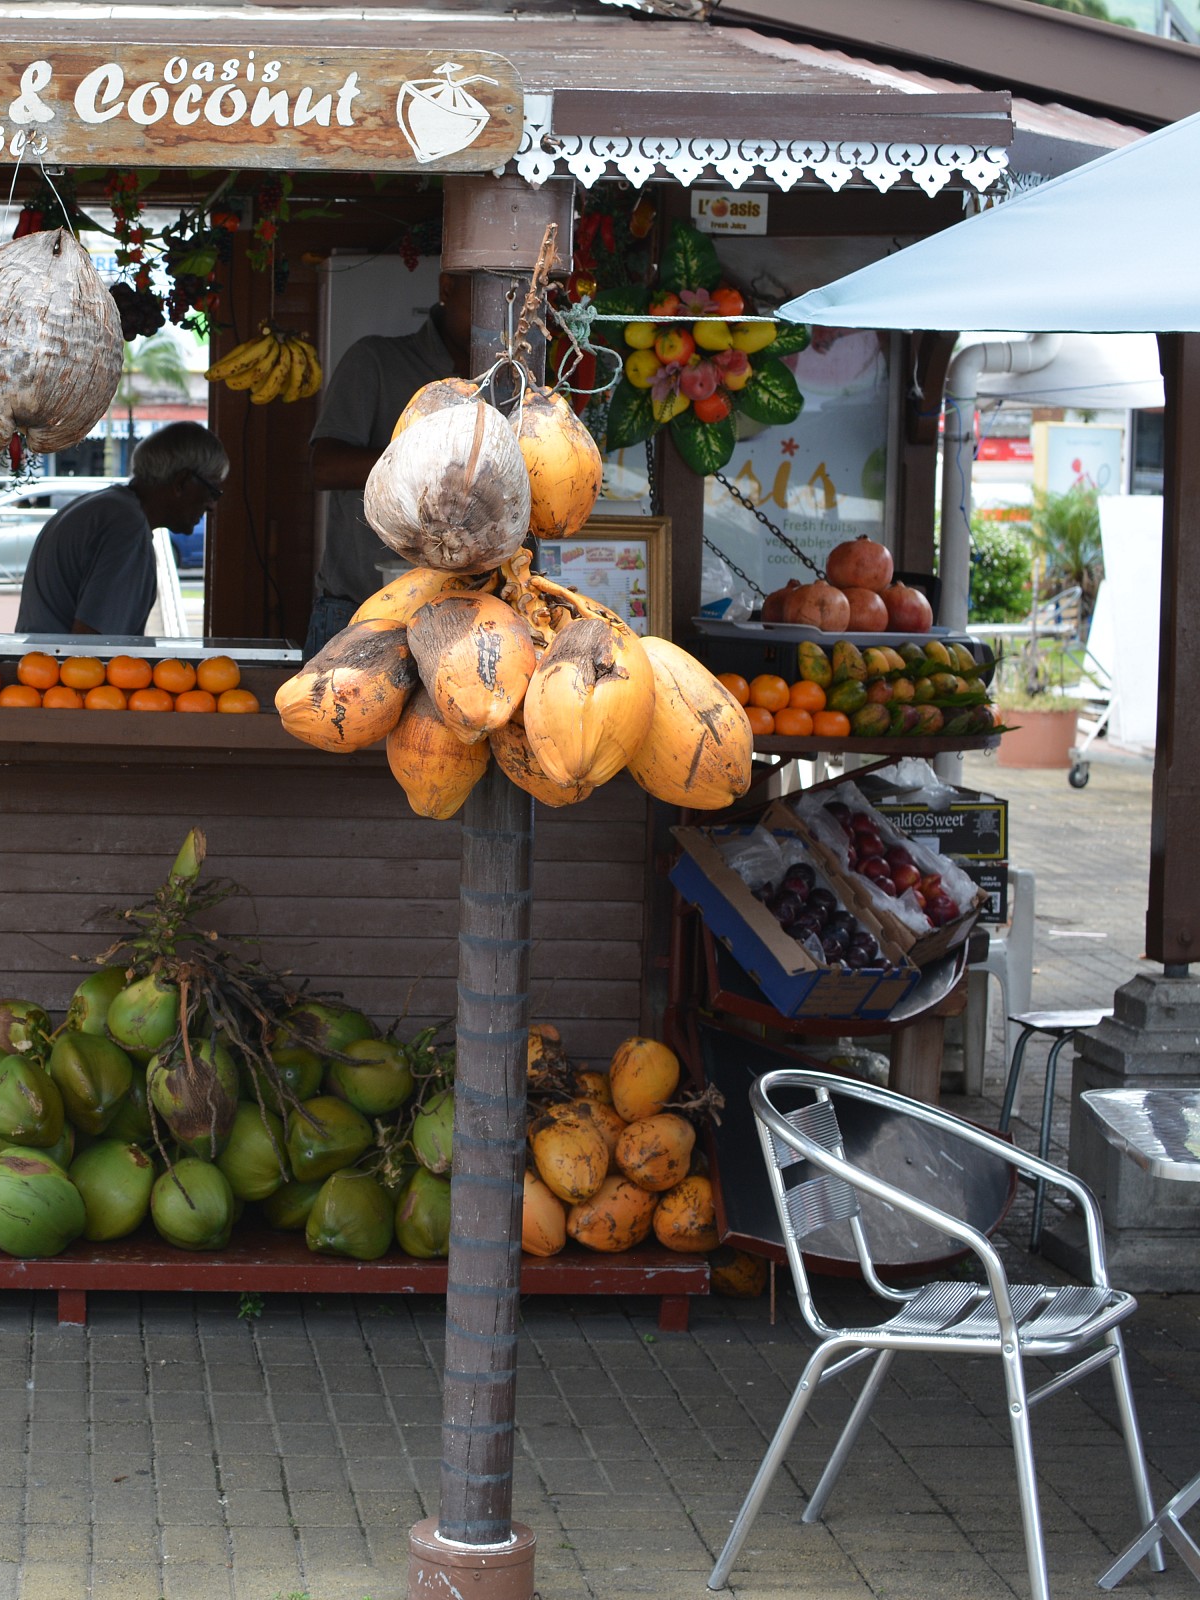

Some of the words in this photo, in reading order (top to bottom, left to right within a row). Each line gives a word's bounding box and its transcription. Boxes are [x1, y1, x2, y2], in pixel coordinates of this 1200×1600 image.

[163, 51, 282, 84] Oasis
[8, 60, 55, 124] &
[74, 64, 360, 127] Coconut
[710, 221, 729, 229] Fresh
[730, 222, 747, 230] Juice
[783, 518, 816, 531] Fresh
[925, 812, 965, 827] Sweet
